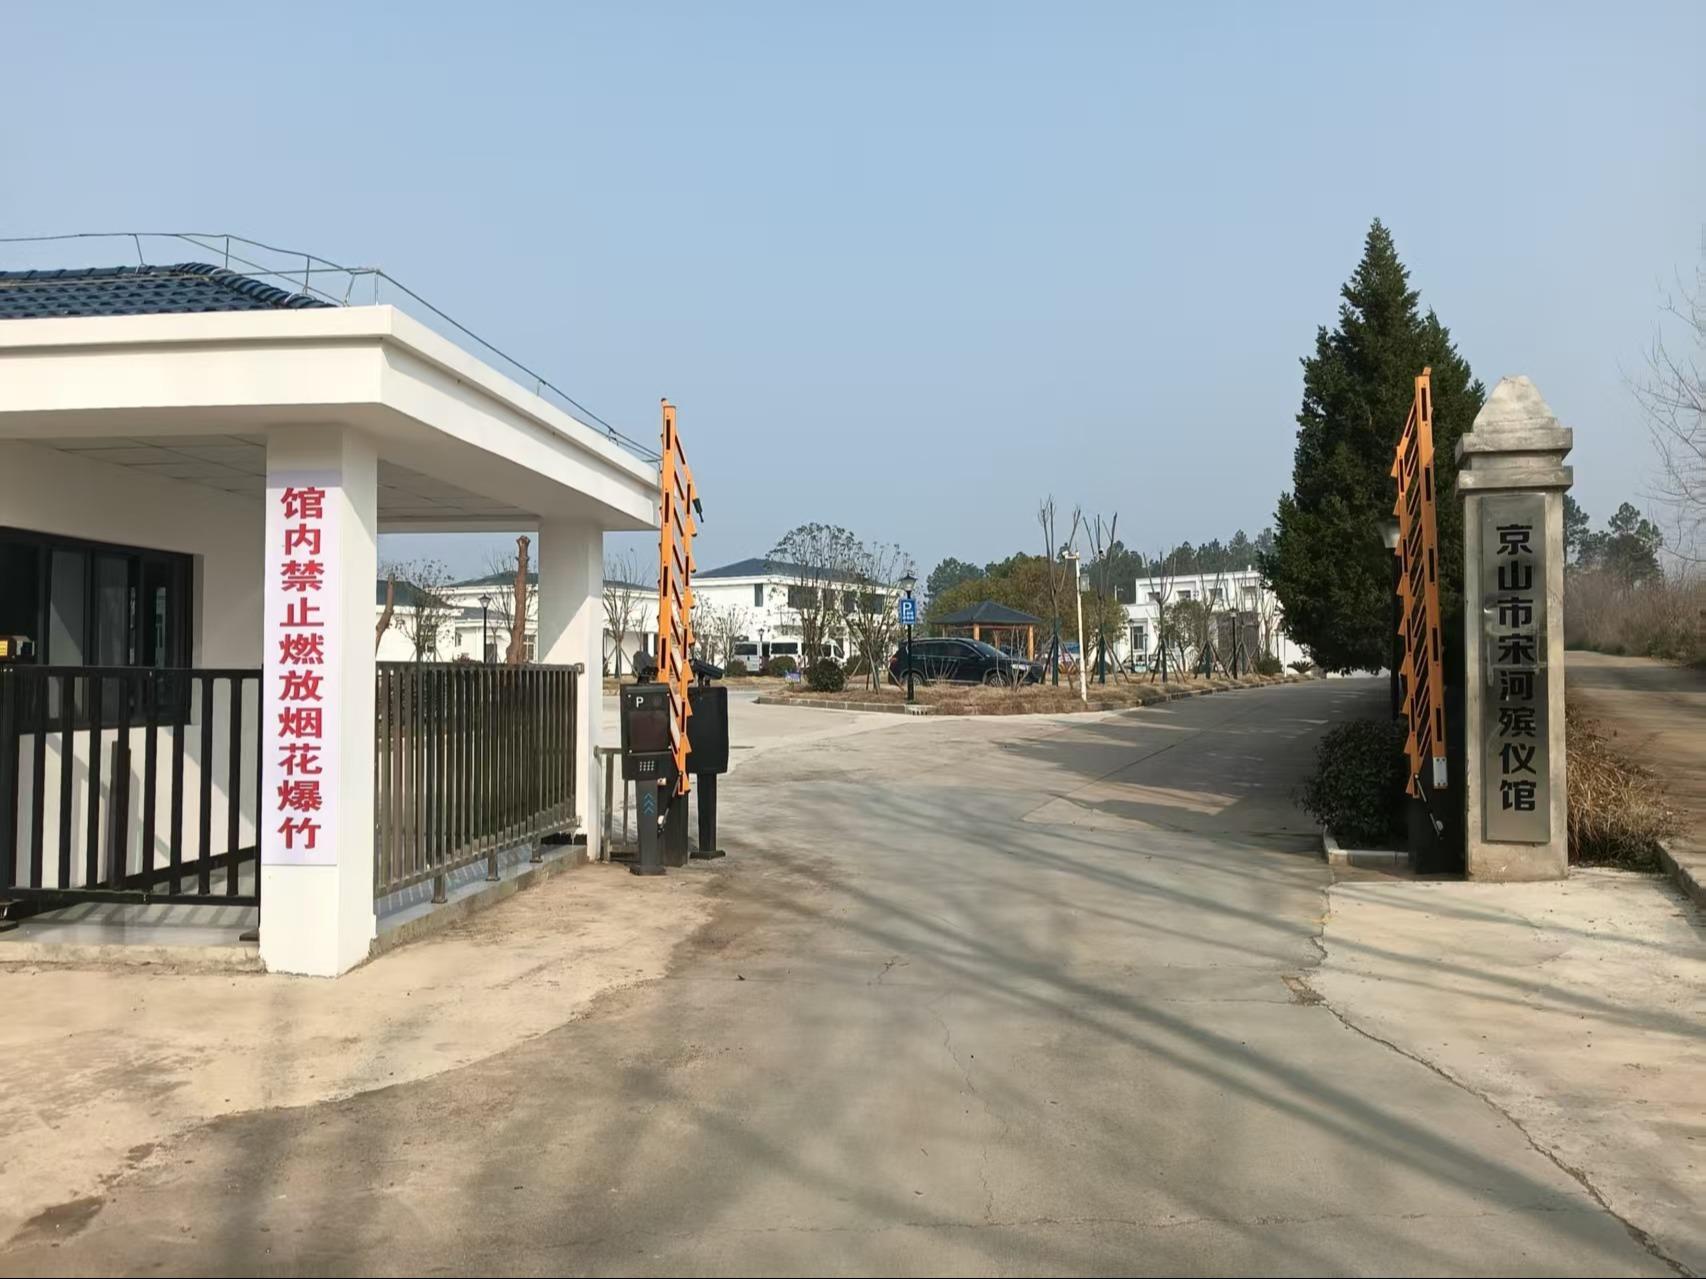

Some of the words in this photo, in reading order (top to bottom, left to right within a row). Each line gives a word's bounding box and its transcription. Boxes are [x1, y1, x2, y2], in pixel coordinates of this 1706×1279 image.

[277, 487, 326, 849] 馆内禁止燃放烟花爆竹
[903, 602, 912, 616] P
[1496, 524, 1537, 812] 京山市宋河殡仪馆
[636, 696, 644, 708] P
